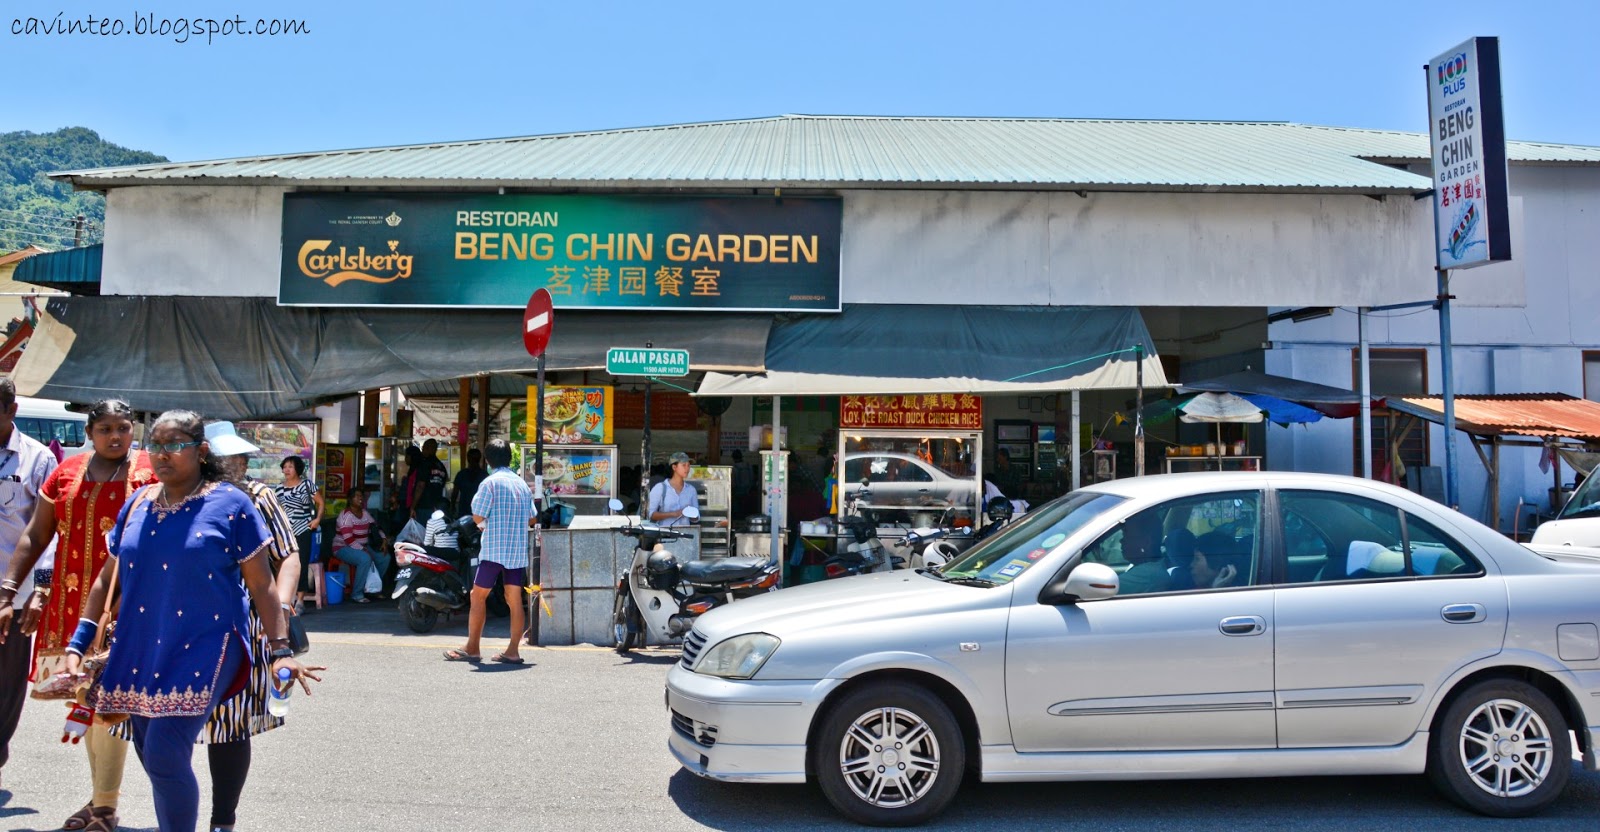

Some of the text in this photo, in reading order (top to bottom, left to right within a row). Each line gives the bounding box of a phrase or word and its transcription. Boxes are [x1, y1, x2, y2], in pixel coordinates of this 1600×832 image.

[1443, 77, 1466, 98] PLUS
[1444, 98, 1466, 112] RESTORAN
[1439, 106, 1474, 141] BENG
[1442, 135, 1473, 168] CHIN
[1440, 160, 1478, 182] GARDEN
[456, 211, 558, 227] RESTORAN
[455, 232, 818, 263] BENG CHIN GARDEN
[298, 240, 414, 280] Carlsberg
[546, 264, 721, 297] 茗津园餐室
[612, 351, 685, 365] JALAN PASAR
[844, 411, 978, 425] LOY KEE ROAST DUCK CHICKEN RICE
[567, 461, 592, 473] PENANG
